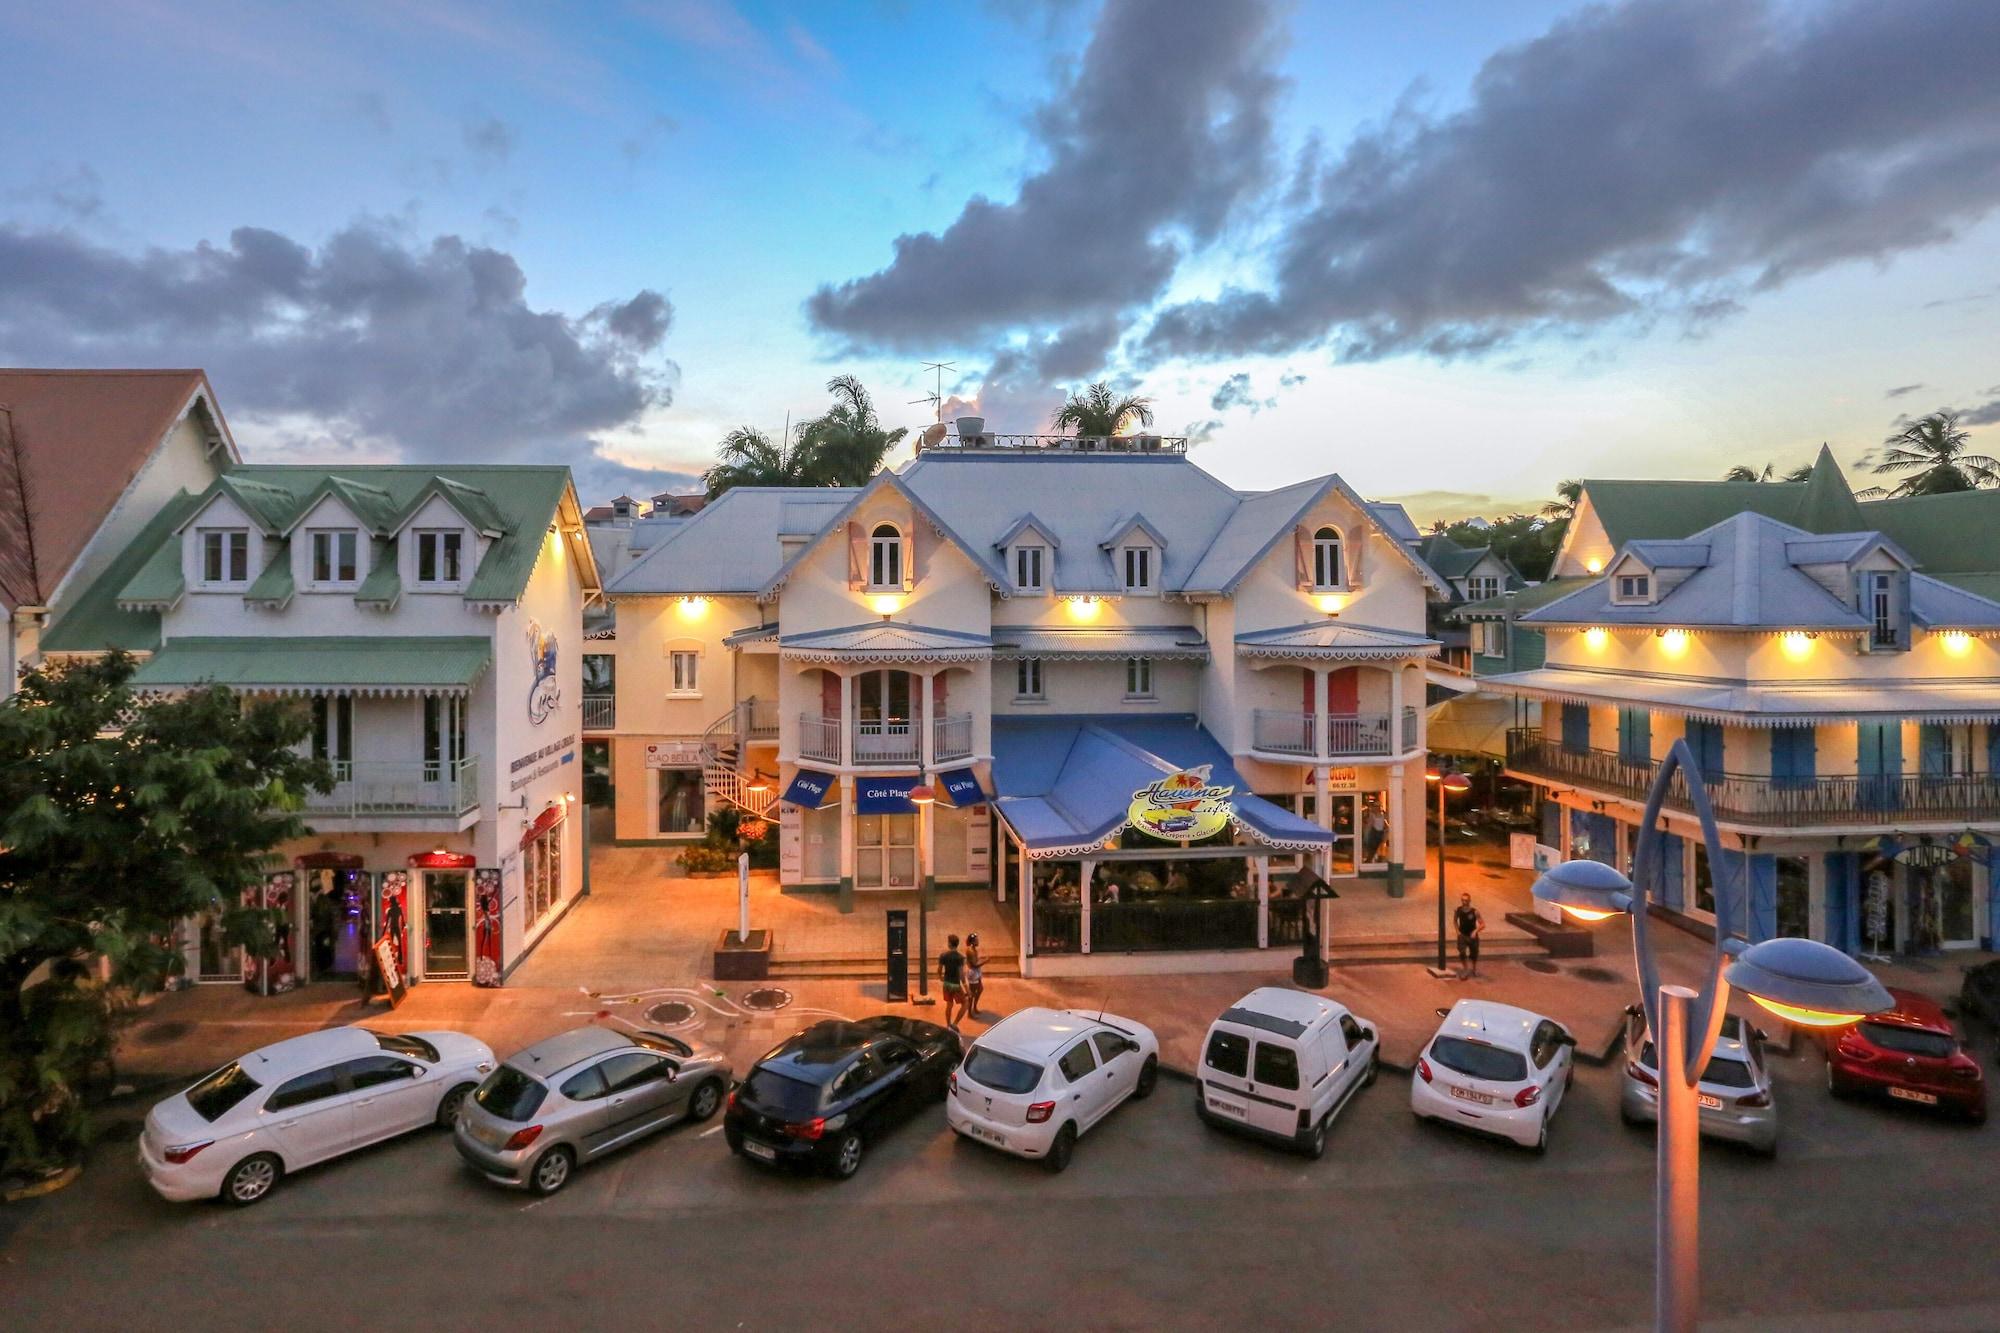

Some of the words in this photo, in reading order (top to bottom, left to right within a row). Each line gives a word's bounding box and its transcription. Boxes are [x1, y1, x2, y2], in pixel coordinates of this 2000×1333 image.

[647, 753, 670, 763] CIAO
[671, 753, 698, 763] BELLA
[797, 779, 810, 790] Côté
[807, 781, 823, 795] Plage
[867, 788, 887, 799] Côté
[949, 783, 962, 793] Côté
[960, 780, 976, 791] Plage
[1134, 783, 1229, 805] Havana
[1192, 799, 1231, 816] Café
[1136, 819, 1160, 835] Brasserie
[1196, 826, 1217, 838] Glacier
[1906, 846, 1952, 867] JUNGLE
